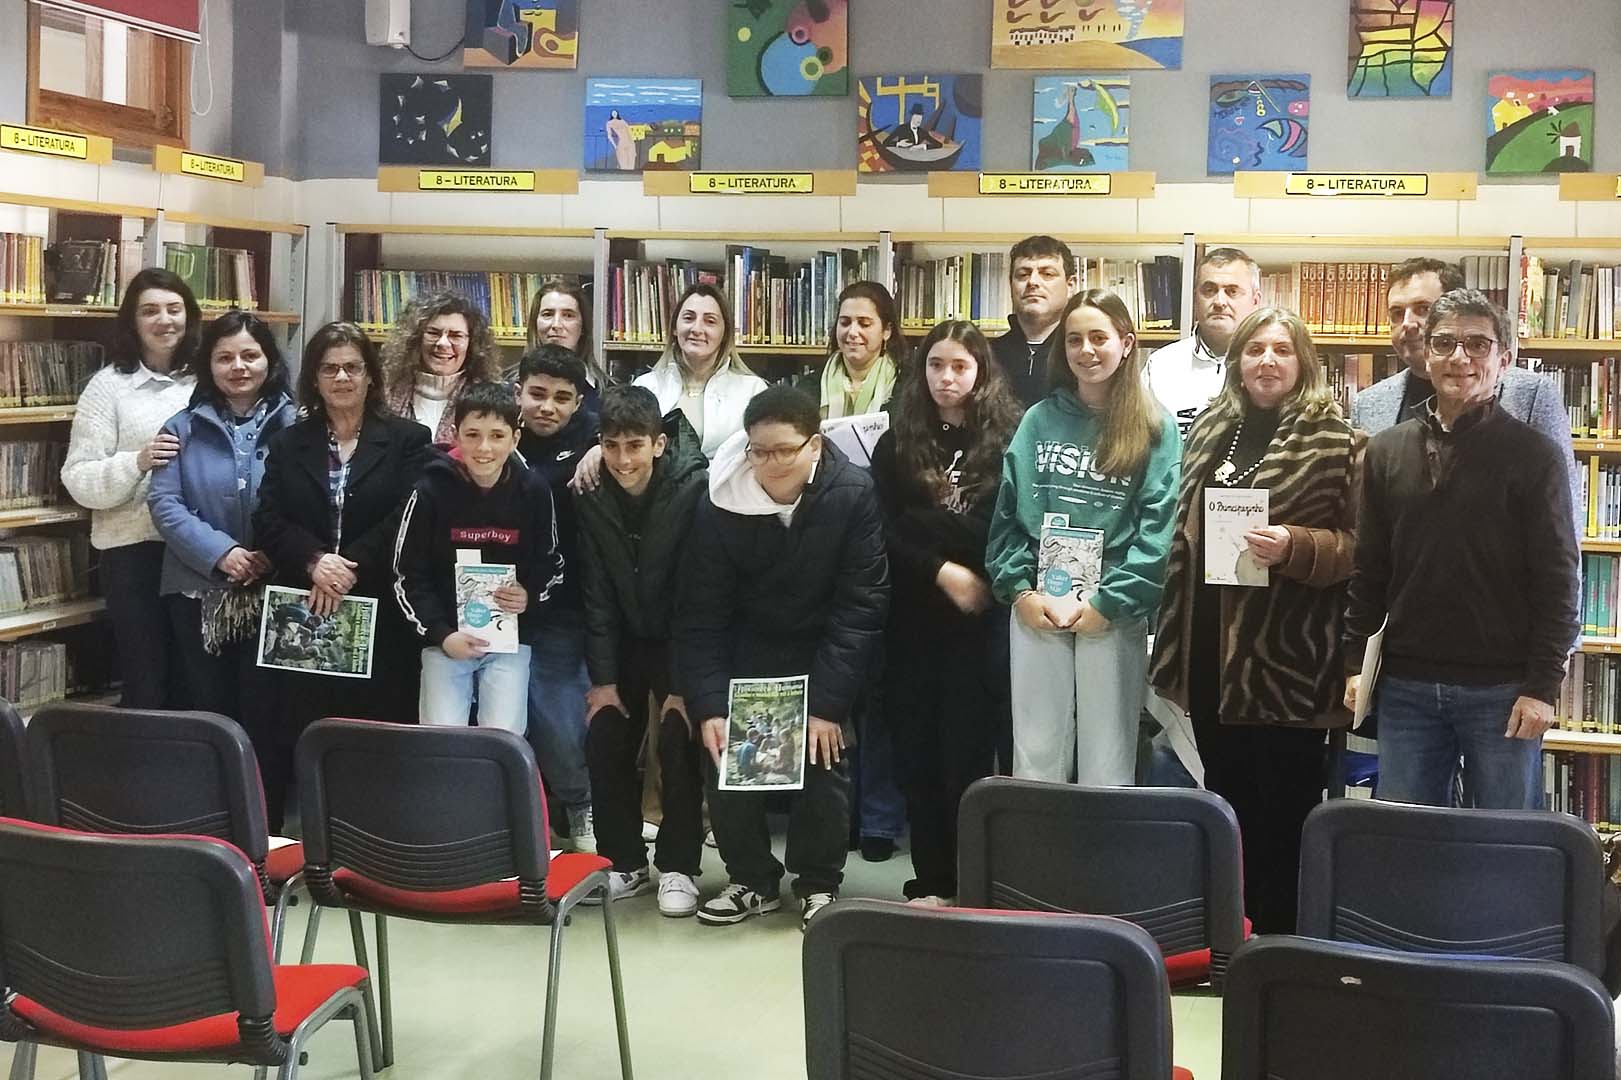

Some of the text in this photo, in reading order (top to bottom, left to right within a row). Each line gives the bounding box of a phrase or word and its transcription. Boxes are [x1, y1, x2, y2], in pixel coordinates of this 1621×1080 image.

[14, 132, 19, 143] 8
[27, 134, 75, 152] LITERATURA
[190, 160, 195, 169] 8
[200, 161, 235, 176] LITERATURA
[436, 175, 442, 185] 8
[453, 175, 518, 187] LITERATURA
[709, 177, 715, 188] 8
[728, 177, 796, 189] LITERATURA
[999, 178, 1007, 189] 8
[1019, 179, 1092, 190] LITERATURA
[1306, 178, 1314, 189] 8
[1328, 179, 1406, 190] LITERATURA
[1035, 440, 1131, 487] VISIO
[460, 530, 512, 542] Superboy
